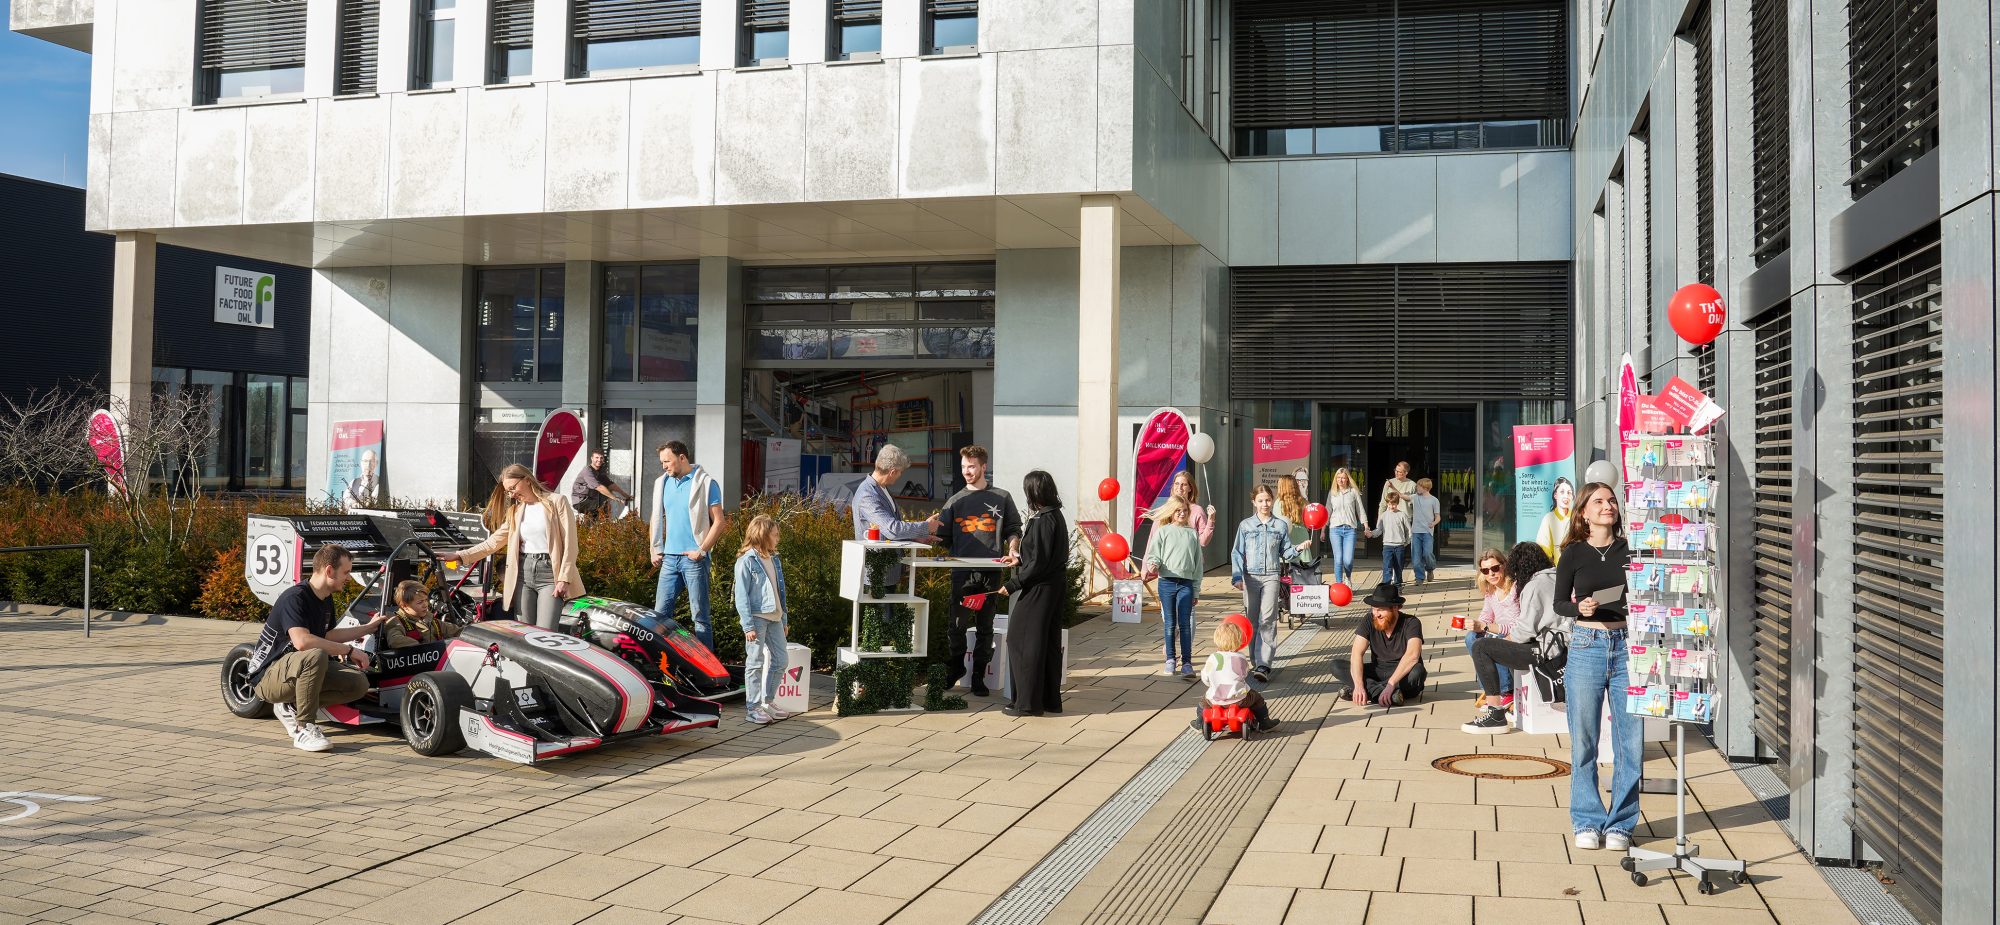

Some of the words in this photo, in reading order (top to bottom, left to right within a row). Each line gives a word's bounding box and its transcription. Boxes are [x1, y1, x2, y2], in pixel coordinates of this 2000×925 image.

[224, 274, 253, 288] FUTURE
[234, 288, 253, 299] FOOD
[219, 298, 253, 311] FACTORY
[1699, 303, 1716, 313] TH
[238, 312, 252, 323] OWL
[1708, 313, 1723, 324] OWL
[1517, 435, 1526, 443] TH
[1145, 442, 1184, 450] WILLKOMMEN
[255, 544, 281, 575] 53
[1116, 596, 1127, 604] TH
[1296, 601, 1323, 609] Führung
[1120, 605, 1137, 613] OWL
[615, 617, 654, 642] Lemgo
[533, 634, 577, 648] 53
[386, 655, 405, 670] UAS
[407, 650, 440, 666] LEMGO
[779, 685, 802, 697] OWL
